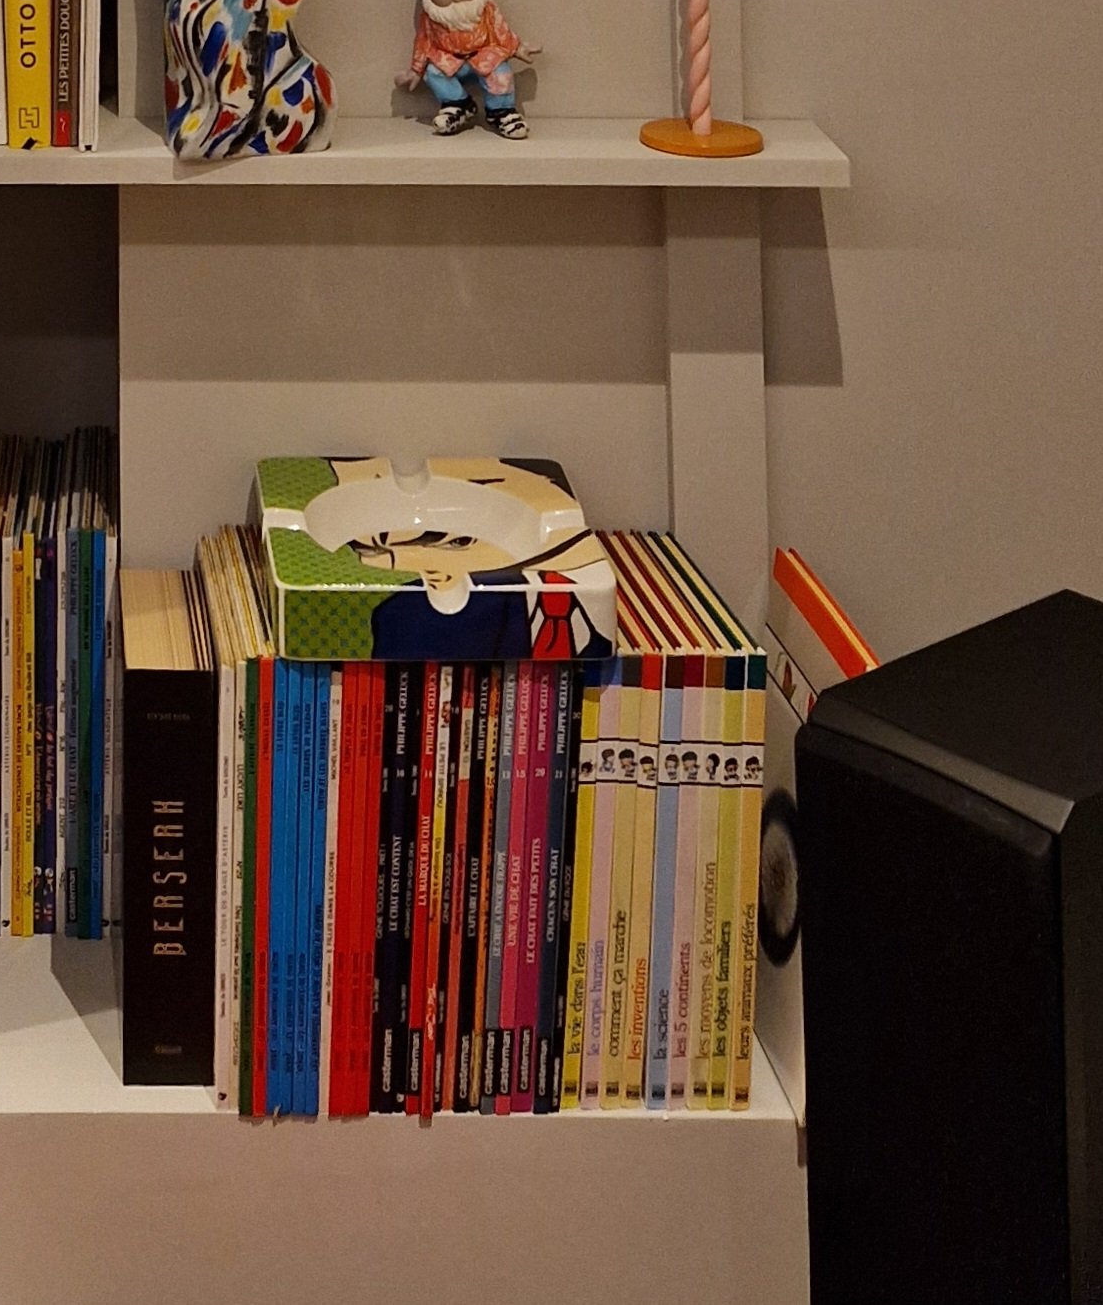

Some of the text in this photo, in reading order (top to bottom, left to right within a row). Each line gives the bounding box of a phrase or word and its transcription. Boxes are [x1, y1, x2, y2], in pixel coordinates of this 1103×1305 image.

[59, 33, 70, 80] PETITES
[58, 81, 69, 102] LES
[555, 709, 566, 754] PHILIPPE
[152, 799, 187, 956] BERSERK
[409, 672, 437, 1091] casterman LA MARQUE CHAT PHILIPPE GELUCK
[529, 874, 539, 894] DES
[531, 837, 541, 873] PETITS
[548, 878, 557, 899] SON
[549, 848, 559, 876] CHAT
[382, 712, 406, 1093] casterman LE CHAT EST CONTENT PHILIPPE
[527, 920, 537, 949] CHAT
[499, 854, 520, 1094] casterman UNE VIE DE CHAT
[526, 951, 535, 964] LE
[608, 910, 627, 1057] comment ça marche
[695, 861, 716, 1060] les moyens de locomotion
[713, 920, 731, 1058] les objets familiers
[736, 903, 757, 1061] leurs animaux préférés
[567, 941, 586, 1055] la vie dans l'eau
[587, 939, 606, 1056] le corps humain
[627, 958, 646, 1061] les inventions
[653, 988, 669, 1060] la science
[672, 942, 690, 1058] les 5 continents
[458, 1035, 469, 1099] casterman
[484, 1031, 495, 1095] casterman
[519, 1029, 530, 1091] casterman
[538, 1039, 547, 1096] casterman
